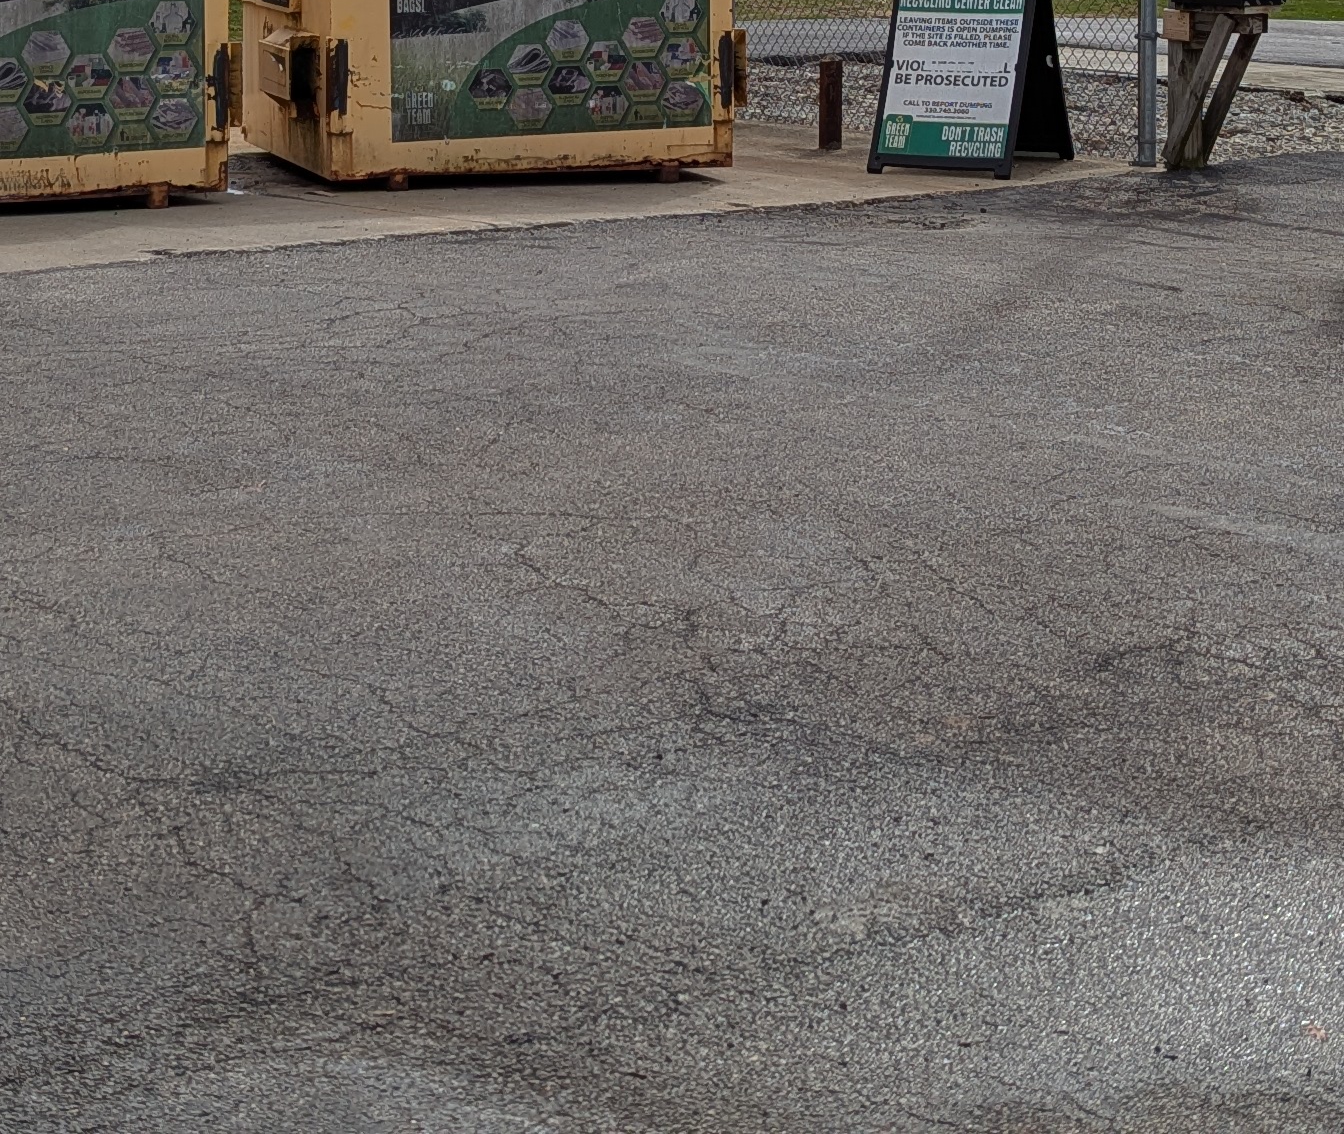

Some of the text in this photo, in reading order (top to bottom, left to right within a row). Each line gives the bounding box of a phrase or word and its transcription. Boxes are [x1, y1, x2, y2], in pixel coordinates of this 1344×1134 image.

[899, 16, 1020, 26] LEAVING ITEMS OUTSIDE THESE
[896, 24, 946, 33] CONTAINERS
[956, 25, 978, 33] OPEN
[979, 26, 1020, 34] DUMPING.
[927, 32, 943, 40] SITE
[954, 33, 982, 41] FILLED,
[903, 39, 926, 47] COME
[927, 39, 948, 47] BACK
[949, 40, 988, 48] ANOTHER
[894, 73, 1009, 88] BE PROSECUTED
[405, 91, 434, 109] GREEN
[903, 99, 920, 107] CALL
[407, 108, 432, 125] TEAM
[885, 120, 911, 136] GREEN
[941, 125, 1004, 142] DON'T TRASH
[885, 134, 906, 149] TEAM
[948, 141, 1002, 157] RECYCLING
